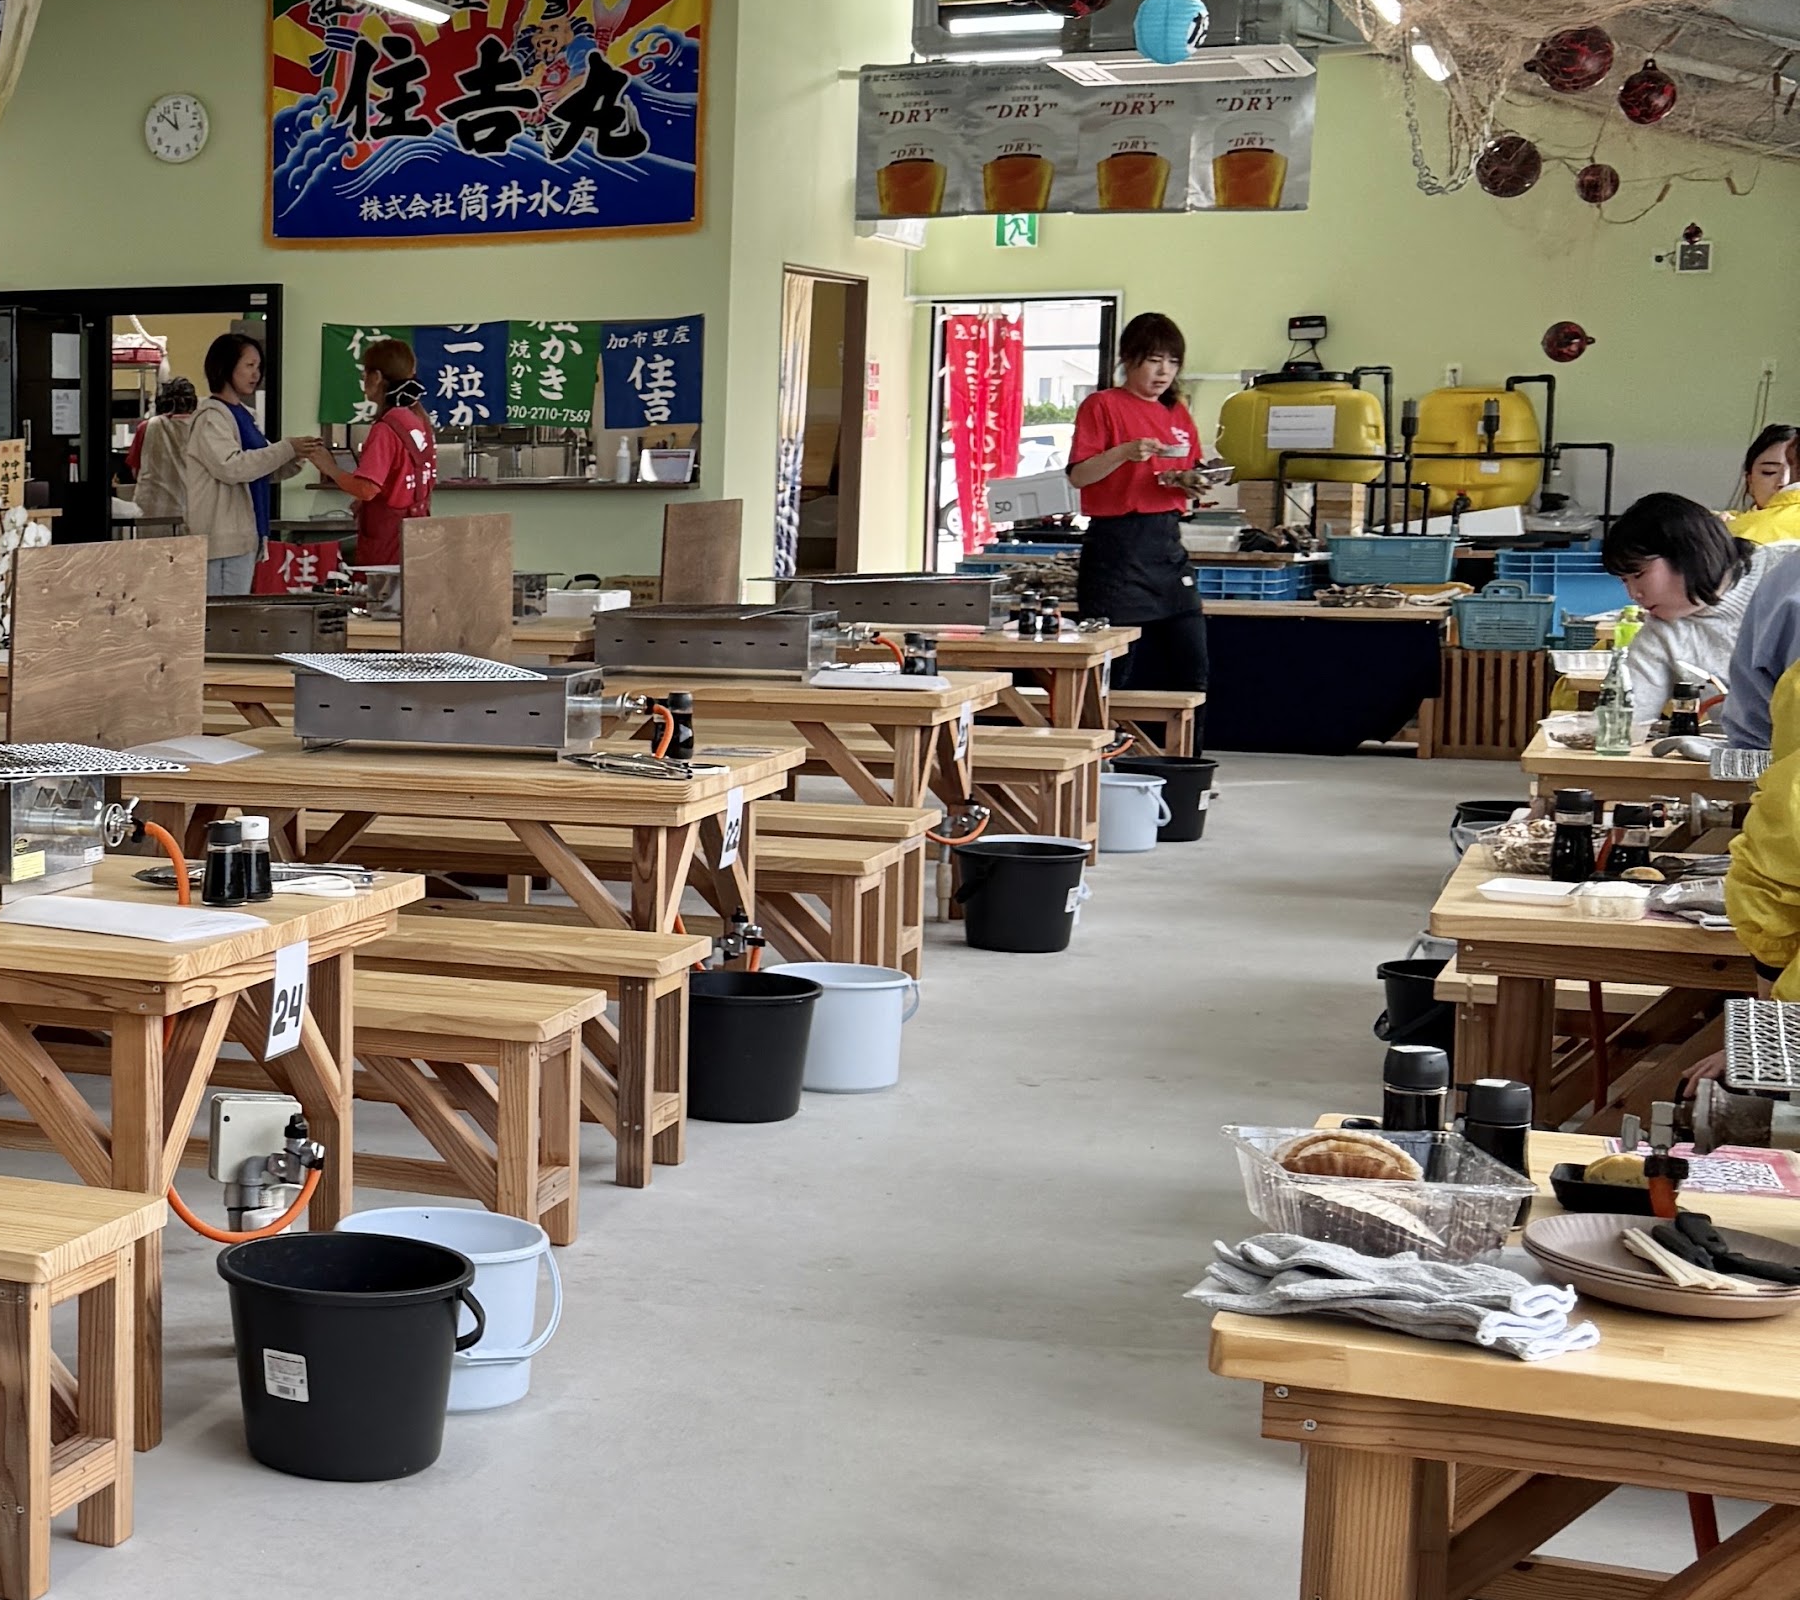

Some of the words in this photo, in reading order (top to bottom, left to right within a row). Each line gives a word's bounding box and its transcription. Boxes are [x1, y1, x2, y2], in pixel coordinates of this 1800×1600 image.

[333, 32, 651, 164] 住吉丸
[358, 175, 600, 223] 株式会社筒井水産
[606, 325, 691, 351] 加布里産
[509, 338, 533, 401] 焼かき
[627, 353, 677, 426] 住吉
[272, 982, 304, 1037] 24
